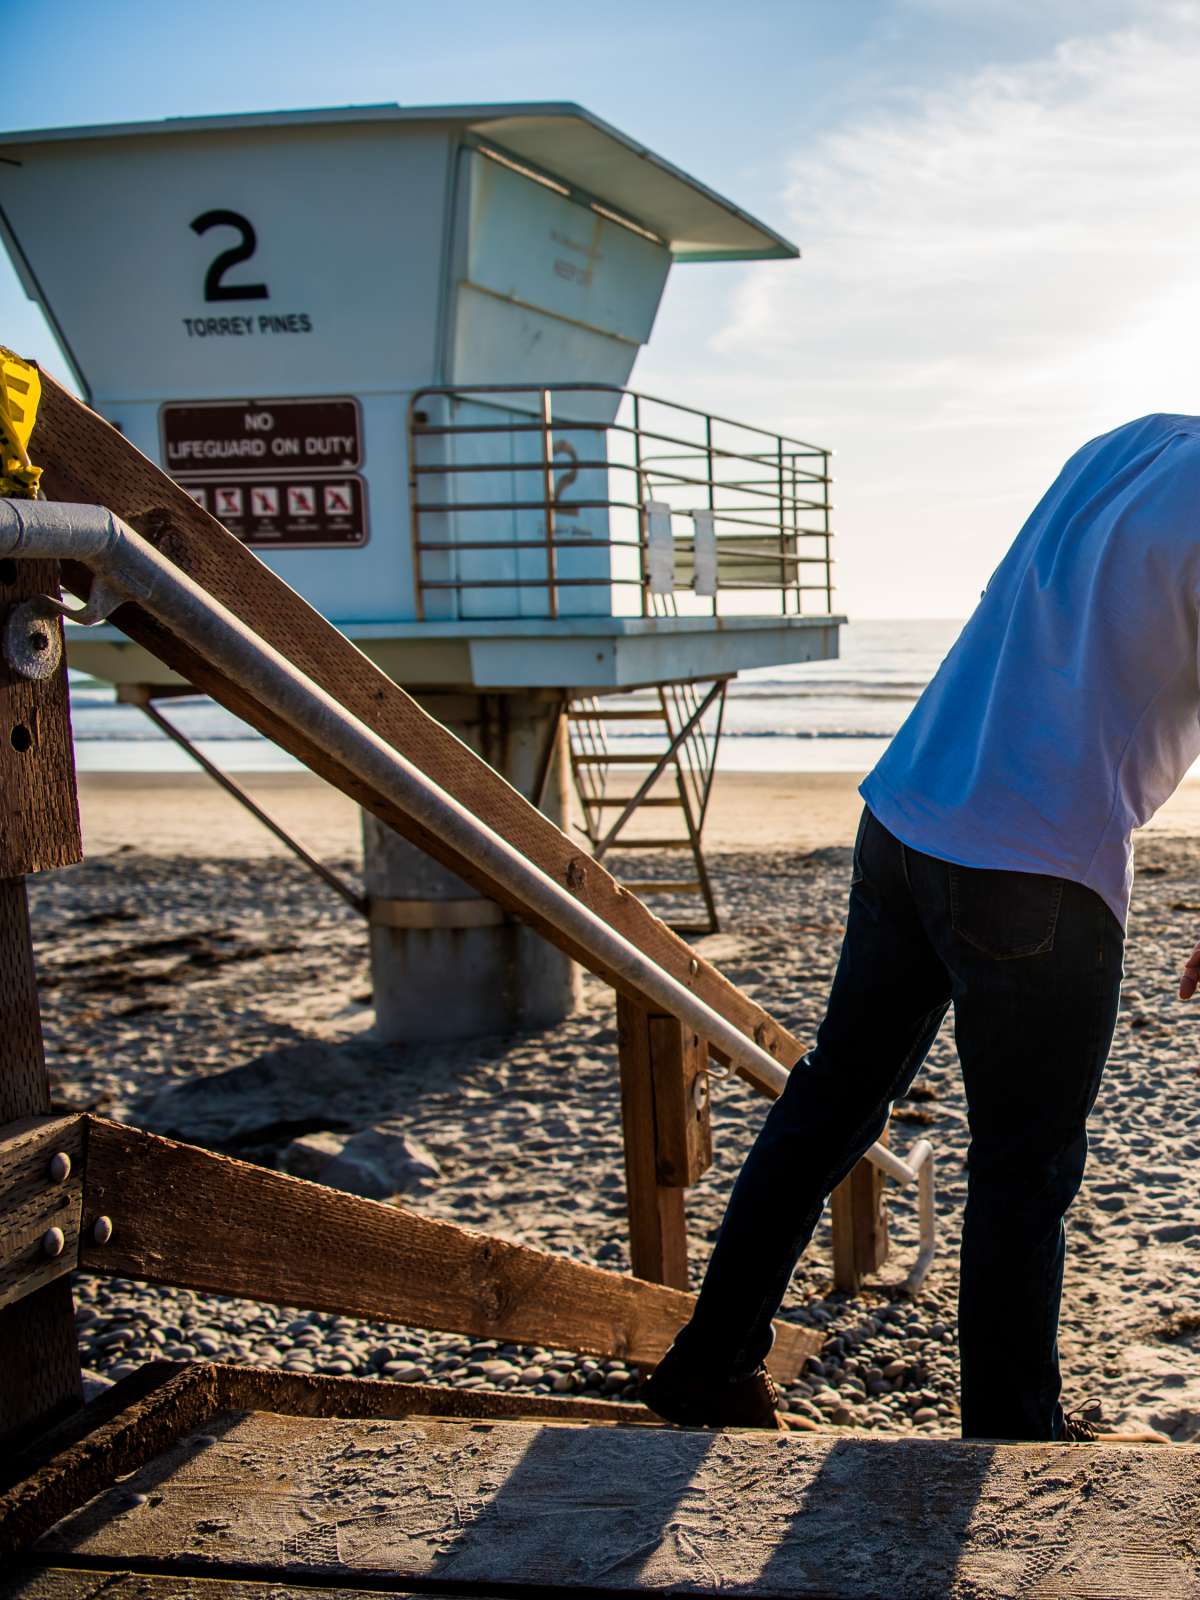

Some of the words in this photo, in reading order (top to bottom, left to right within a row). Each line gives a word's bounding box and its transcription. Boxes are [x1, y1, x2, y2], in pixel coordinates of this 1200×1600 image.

[189, 208, 270, 302] 2
[182, 315, 254, 337] TORREY
[258, 313, 313, 334] PINES
[244, 412, 274, 431] NO
[168, 438, 266, 460] LIFEGUARD
[271, 437, 299, 456] ON
[305, 435, 355, 455] DUTY
[550, 439, 581, 516] 2
